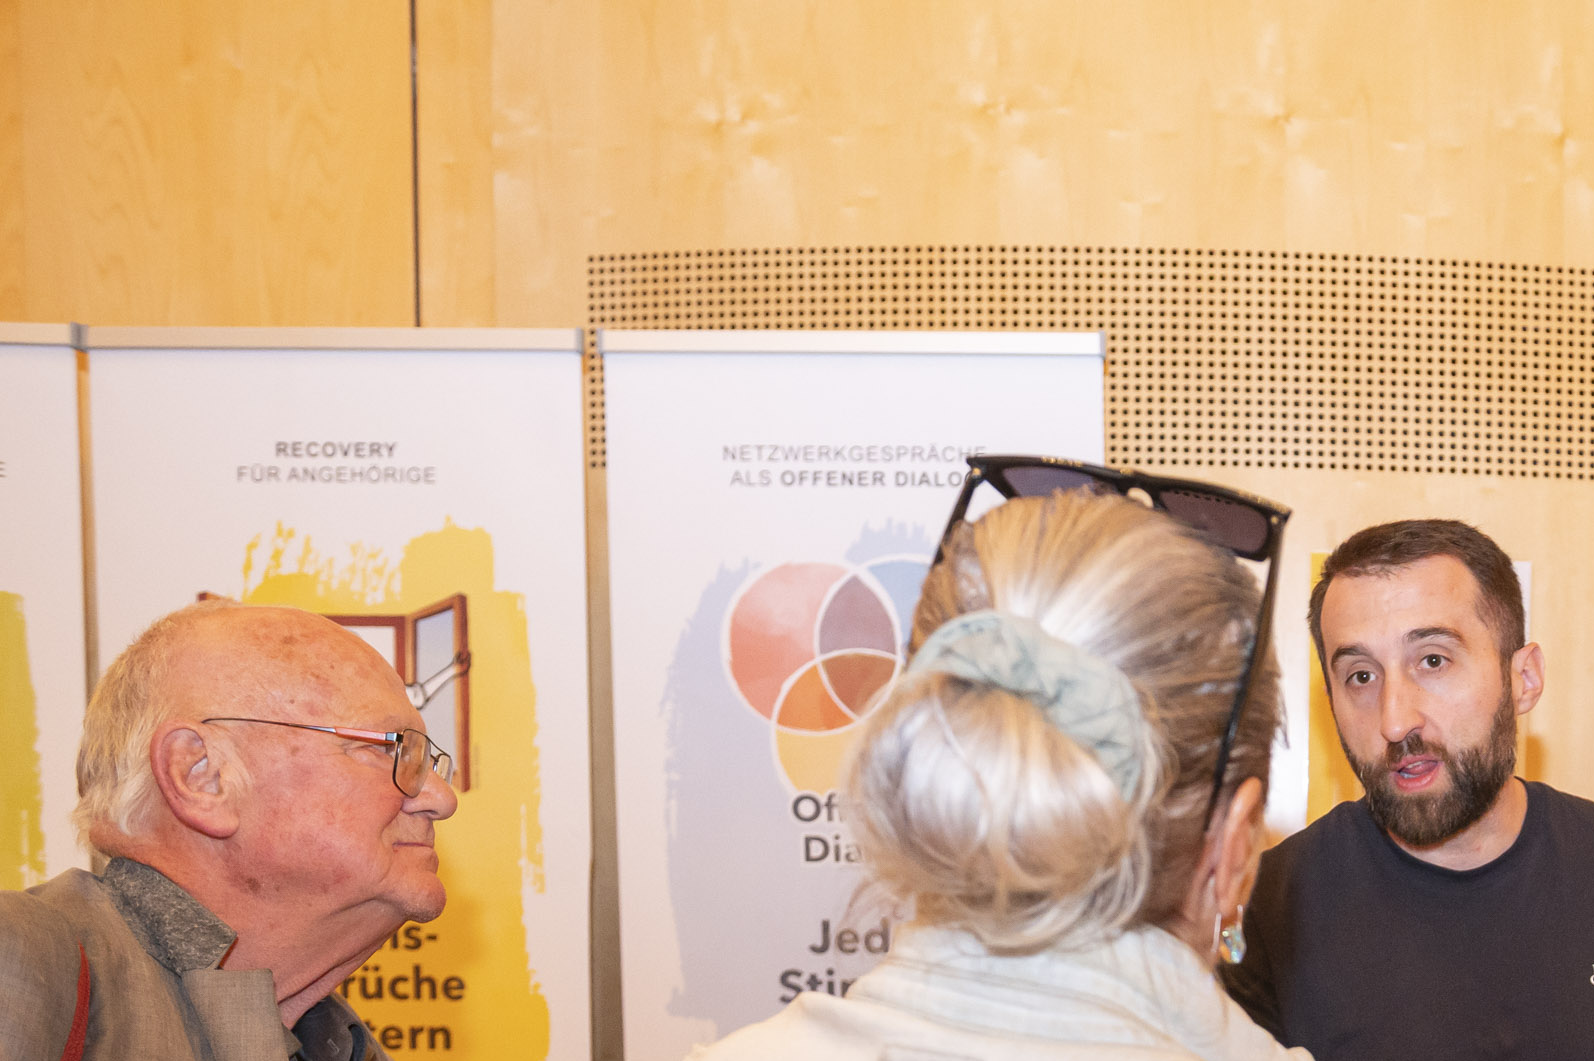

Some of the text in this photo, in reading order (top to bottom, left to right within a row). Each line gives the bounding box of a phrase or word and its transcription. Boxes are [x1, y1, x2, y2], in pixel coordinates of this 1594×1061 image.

[275, 441, 397, 459] RECOVERY
[237, 462, 437, 485] FÜR ANGEHÖRIGE
[730, 469, 965, 488] ALS OFFENER DIALO
[341, 963, 465, 1001] rüche
